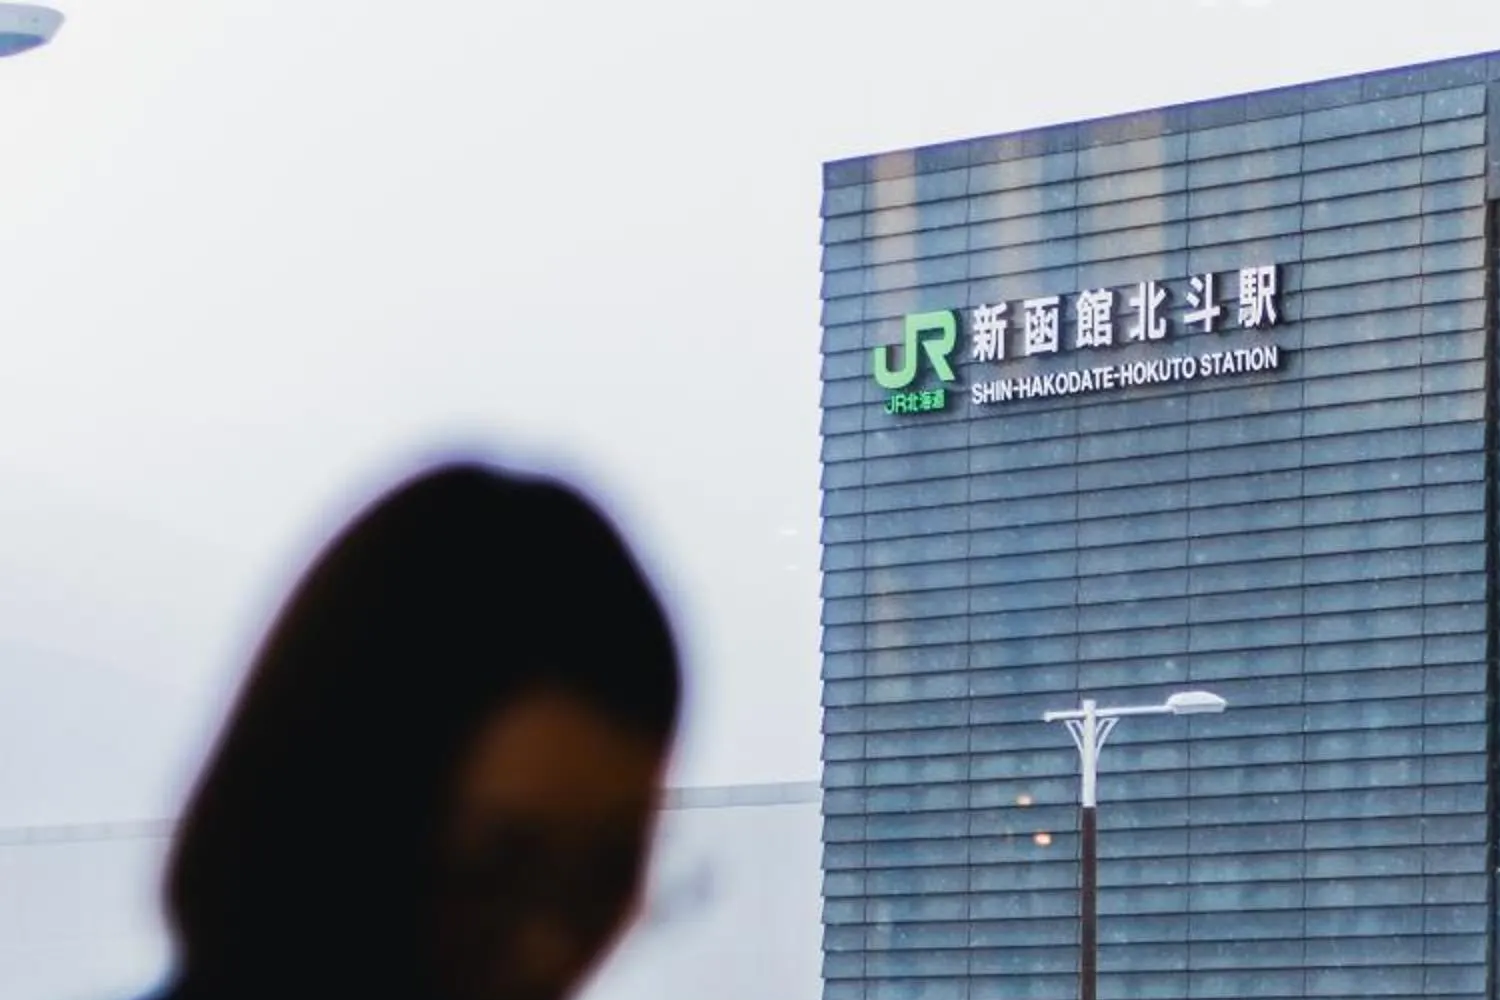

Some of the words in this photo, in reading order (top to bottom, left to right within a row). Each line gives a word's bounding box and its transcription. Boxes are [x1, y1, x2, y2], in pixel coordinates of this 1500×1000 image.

[874, 310, 957, 390] JR
[972, 264, 1277, 362] 新函館北斗駅
[971, 355, 1197, 405] SHIN-HAKODATE-HOKUTO
[1200, 345, 1278, 378] STATION
